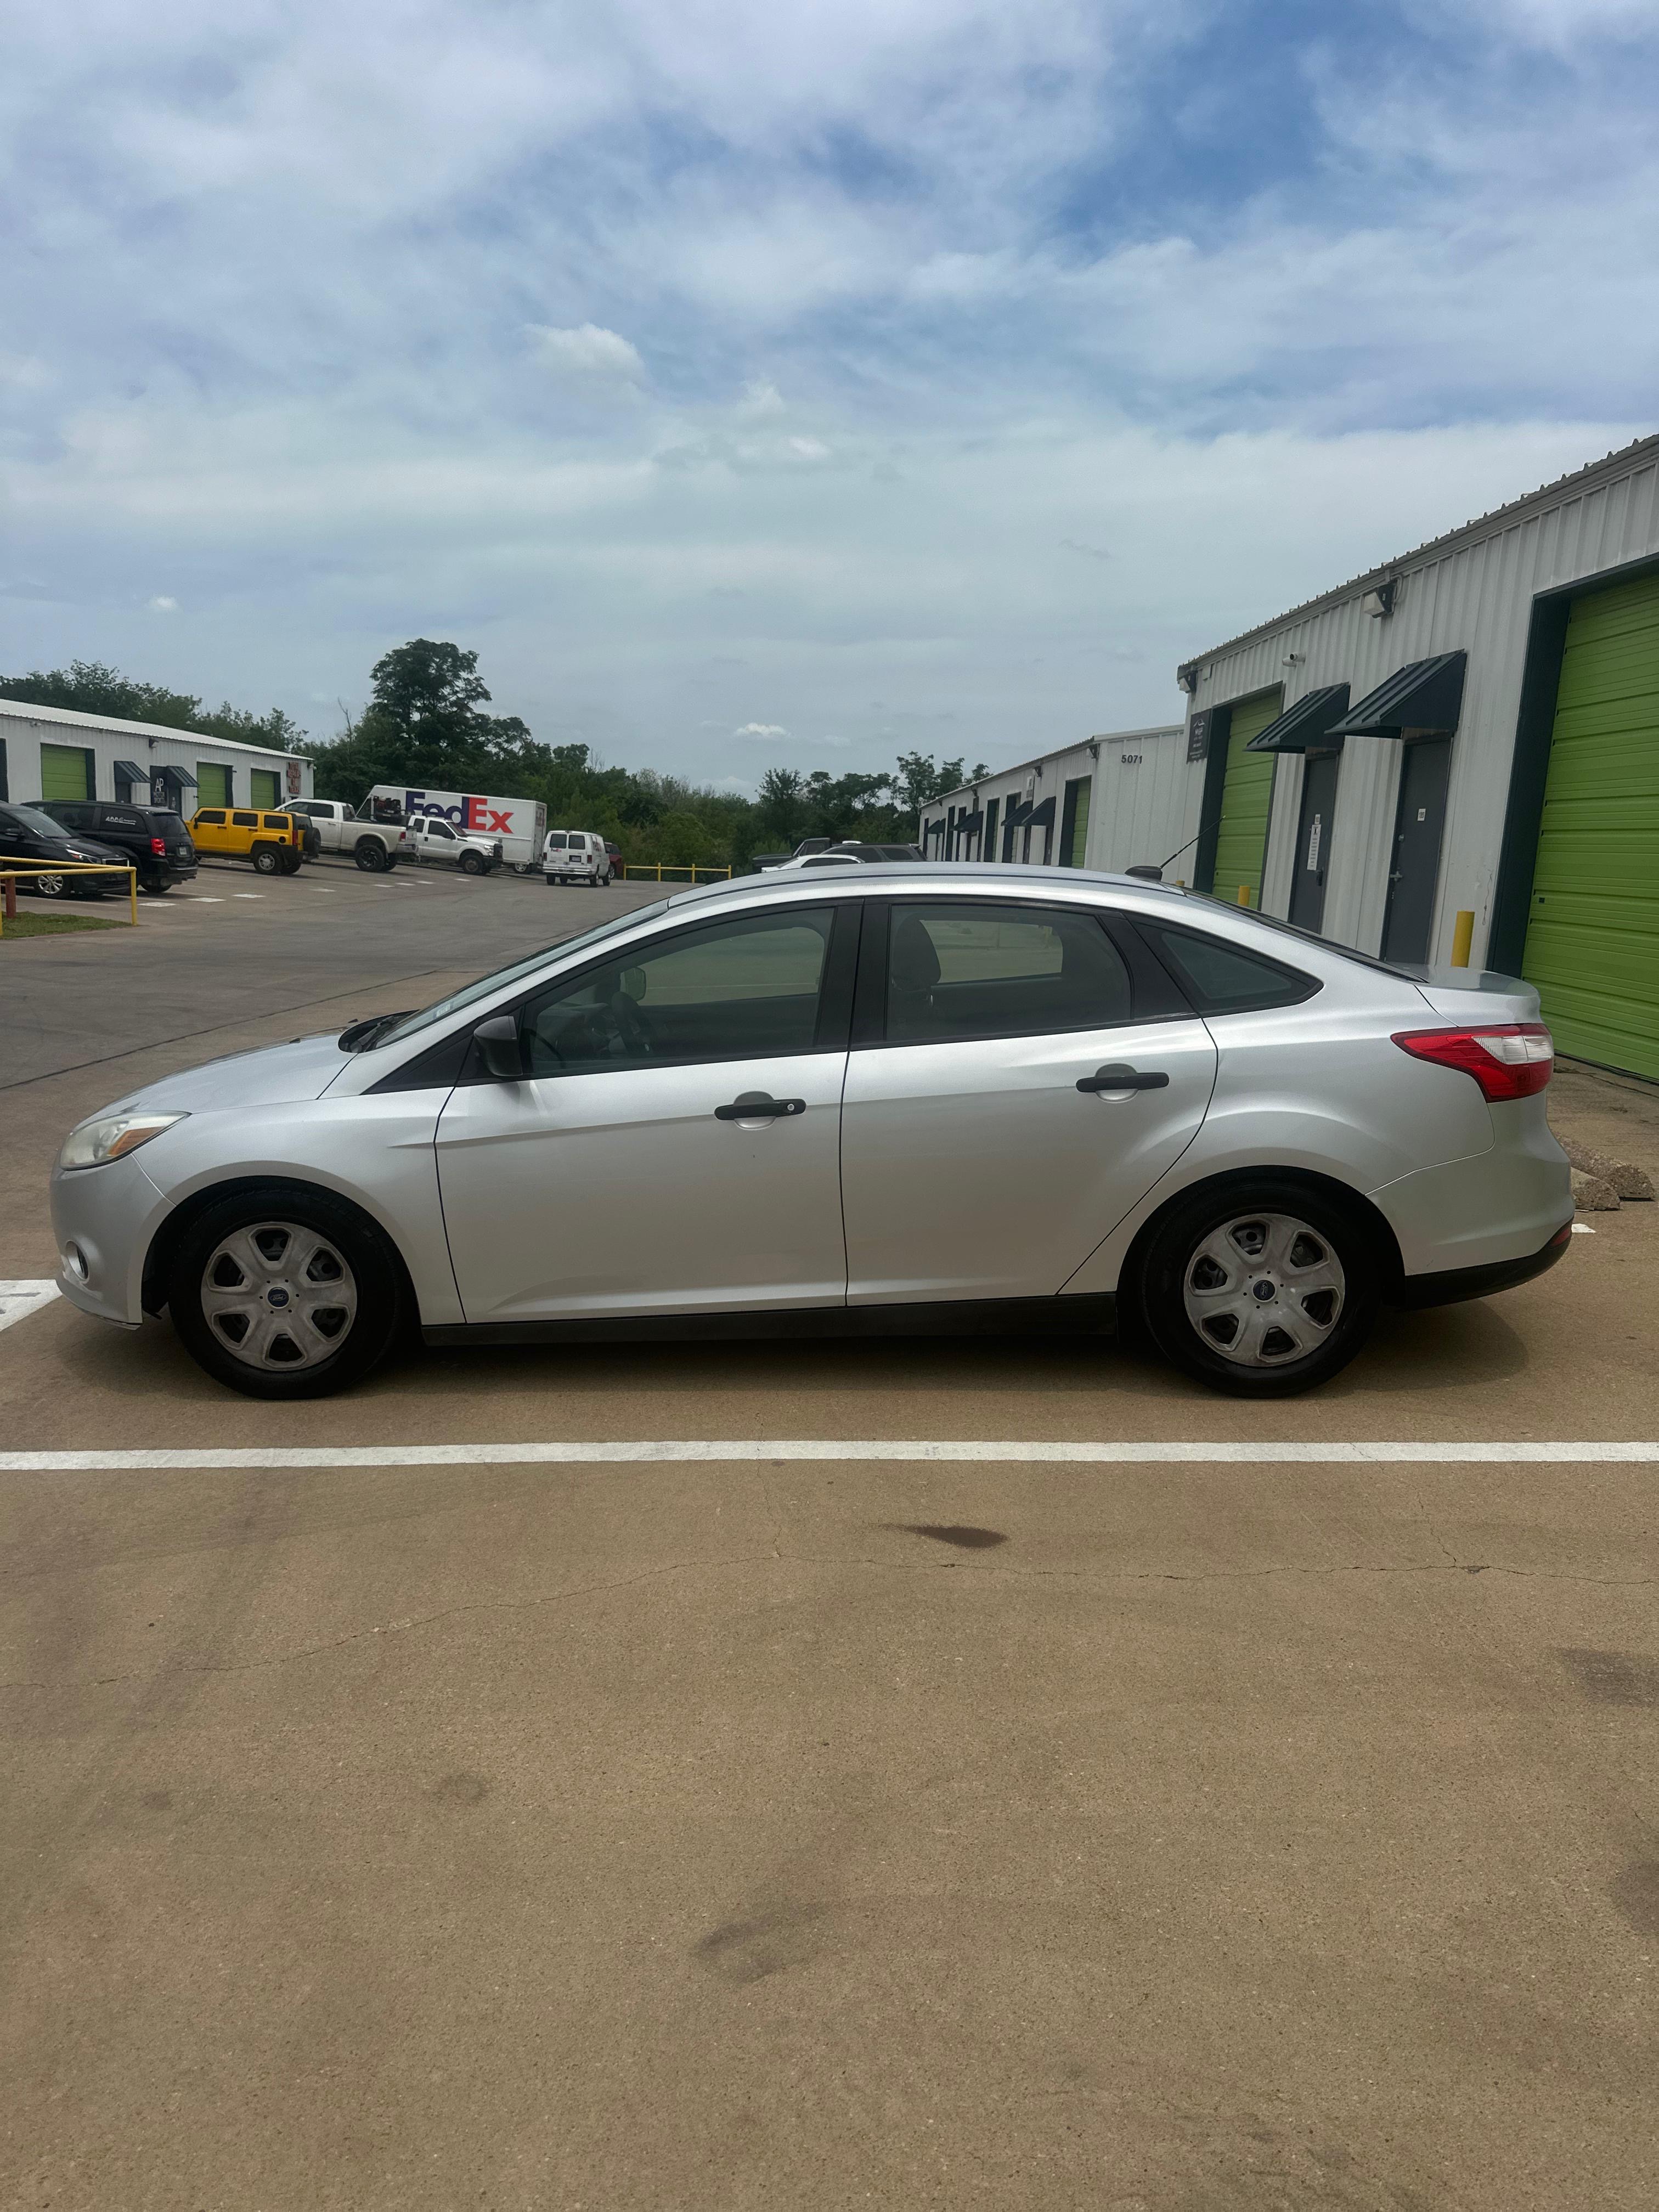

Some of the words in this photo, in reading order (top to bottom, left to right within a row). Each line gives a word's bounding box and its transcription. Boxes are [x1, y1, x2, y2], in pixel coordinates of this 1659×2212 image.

[1121, 754, 1142, 764] 5071
[155, 777, 164, 792] AP
[406, 791, 514, 834] FedEx
